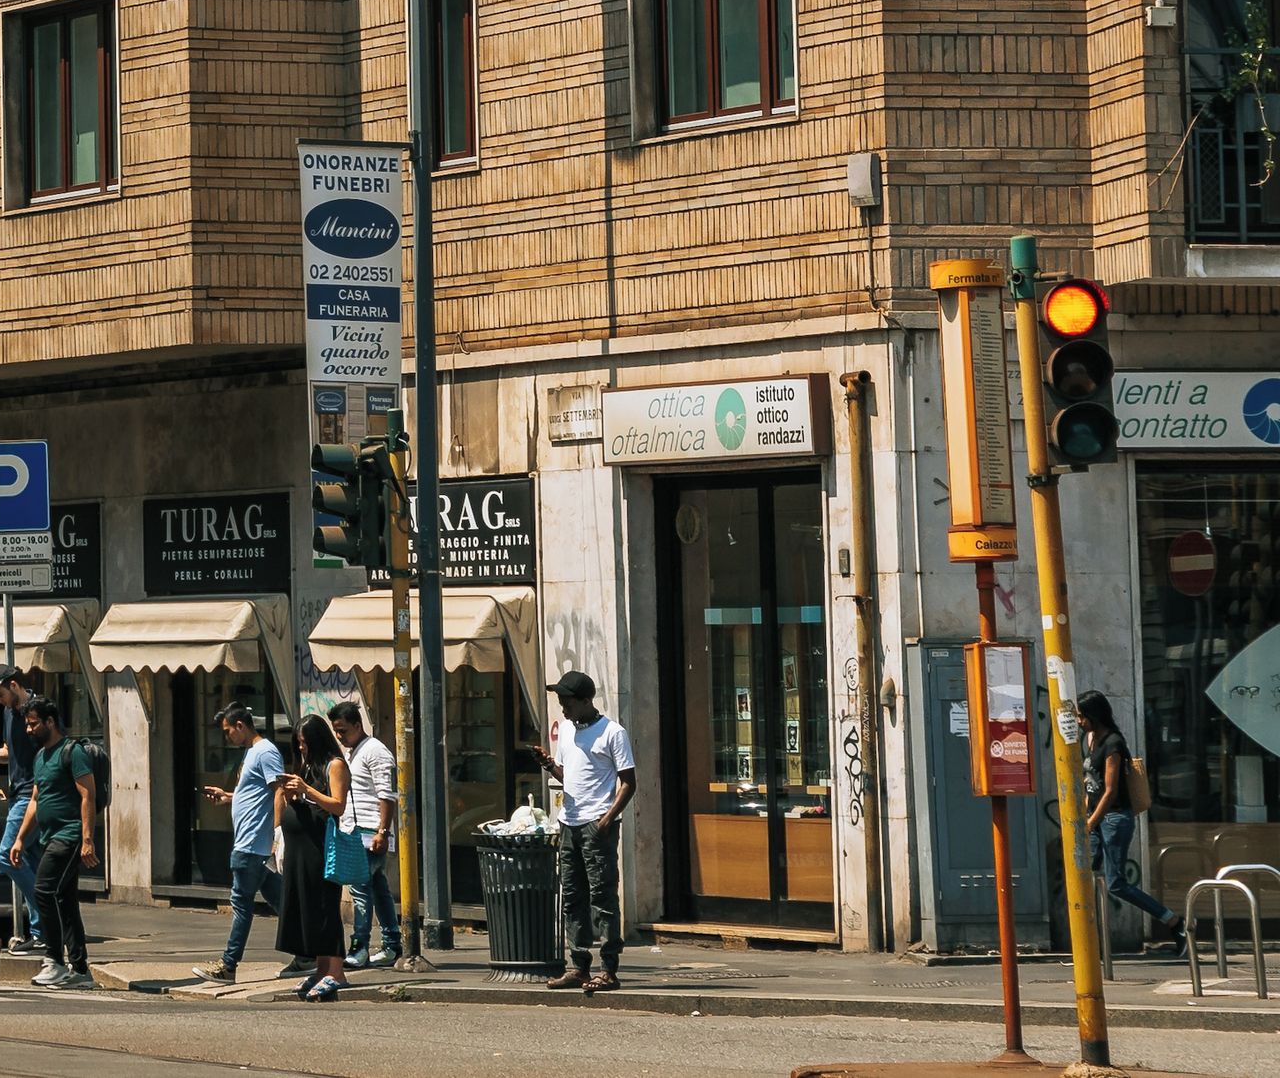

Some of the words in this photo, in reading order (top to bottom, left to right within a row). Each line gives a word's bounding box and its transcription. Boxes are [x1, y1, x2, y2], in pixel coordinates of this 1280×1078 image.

[303, 153, 399, 173] ONORANZE
[312, 175, 390, 193] FUNEBRI
[310, 216, 394, 239] Mancini
[309, 264, 329, 280] 02
[333, 265, 393, 282] 2402551
[948, 274, 990, 284] Fermata
[338, 289, 371, 301] CASA
[319, 304, 389, 318] FUNERARIA
[331, 325, 384, 343] Vicini
[320, 343, 390, 362] quando
[323, 364, 388, 376] occorre
[572, 392, 581, 400] VIA
[755, 384, 795, 403] istituto
[1116, 377, 1183, 405] lenti
[1188, 383, 1209, 405] a
[647, 389, 706, 420] ottica
[756, 407, 789, 424] ottico
[611, 425, 706, 456] oftalmica
[757, 426, 805, 445] randazzi
[160, 504, 264, 543] TURAG
[493, 534, 530, 547] FINITA
[162, 550, 193, 561] PIETRE
[198, 548, 265, 560] SEMIPREZIOSE
[449, 549, 509, 562] MINUTERIA
[0, 568, 22, 577] veicoli
[174, 571, 202, 581] PERLE
[214, 569, 253, 580] CORALLI
[478, 565, 490, 577] IN
[495, 564, 527, 576] ITALY
